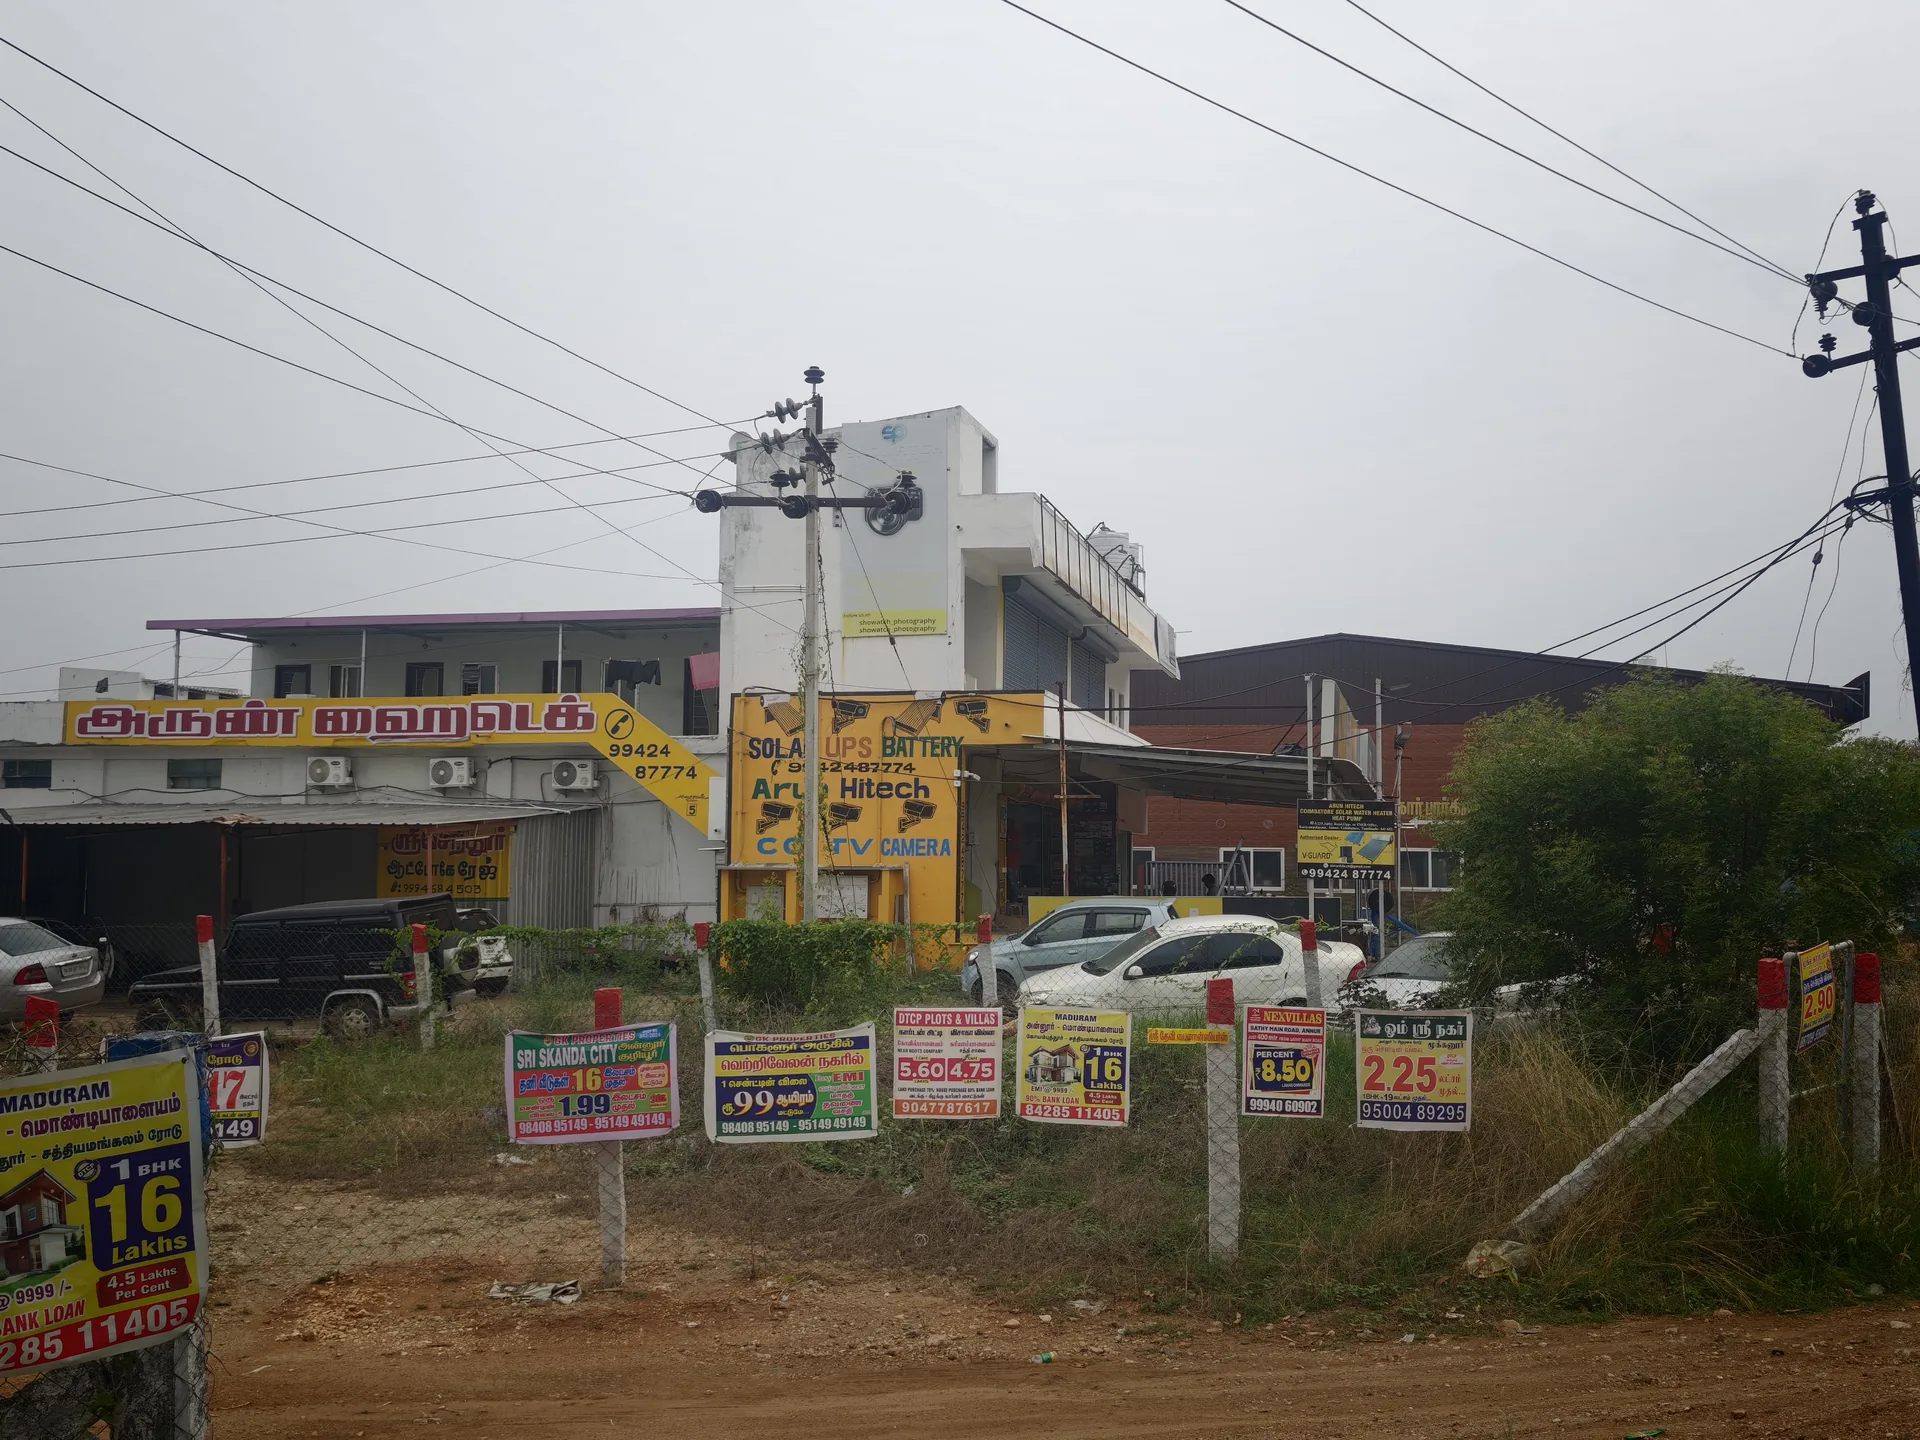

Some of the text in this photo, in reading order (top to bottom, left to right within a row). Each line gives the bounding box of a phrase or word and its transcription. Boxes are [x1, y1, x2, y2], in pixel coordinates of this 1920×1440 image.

[76, 699, 301, 739] அருண்
[609, 743, 671, 758] 99424
[749, 736, 965, 760] SOLA UPS BATTERY
[635, 765, 698, 780] 87774
[788, 762, 916, 774] 942487774
[841, 778, 930, 799] Hitech
[688, 805, 696, 816] 5
[881, 838, 952, 857] CAMERA
[1308, 868, 1391, 880] 99424 87774
[1804, 985, 1833, 1020] 2.90
[899, 1012, 996, 1026] DTCP PLOTS & VILLAS
[1055, 1013, 1097, 1022] MADURAM
[1263, 1010, 1322, 1024] NEXVILLAS
[553, 1036, 569, 1046] GK
[571, 1031, 636, 1046] PROPERTIES
[772, 1032, 836, 1042] PROPERTIES
[1436, 1021, 1464, 1039] நகர்
[517, 1043, 618, 1070] SRI SKANDA CITY
[1093, 1046, 1102, 1056] 1
[721, 1051, 865, 1073] வெற்றிவேலன் நகரில்
[900, 1062, 944, 1078] 5.60
[950, 1062, 992, 1078] 4.75
[1086, 1057, 1122, 1081] 16
[572, 1067, 602, 1092] 16
[778, 1076, 808, 1086] விலை
[833, 1071, 865, 1083] EMI
[1363, 1055, 1437, 1093] 2.25
[1031, 1085, 1043, 1093] EMI
[1090, 1080, 1123, 1090] Lakhs
[0, 1081, 110, 1114] MADURAM
[559, 1093, 611, 1117] 1.99
[733, 1089, 815, 1117] 99 ஆயிரம்
[1025, 1095, 1080, 1105] 90% BANK LOAN
[1250, 1098, 1318, 1113] 99940 60902
[902, 1101, 990, 1114] 9047787617
[1025, 1104, 1120, 1121] 84285 11405
[1362, 1102, 1465, 1121] 95004 89295
[519, 1121, 553, 1135] 98408
[554, 1118, 588, 1133] 95149
[595, 1115, 630, 1130] 95149
[631, 1112, 666, 1127] 49149
[722, 1116, 866, 1134] 98408 95149 95149 49149
[148, 1124, 182, 1142] ரோடு
[110, 1158, 130, 1181] 1
[138, 1157, 182, 1177] BHK
[95, 1174, 183, 1244] 16
[112, 1234, 188, 1265] Lakhs
[107, 1266, 177, 1289] 4.5 Lakhs
[16, 1284, 54, 1305] 9999
[116, 1280, 170, 1301] Per Cent
[0, 1299, 86, 1337] ANK LOAN
[0, 1299, 188, 1369] 285 11405
